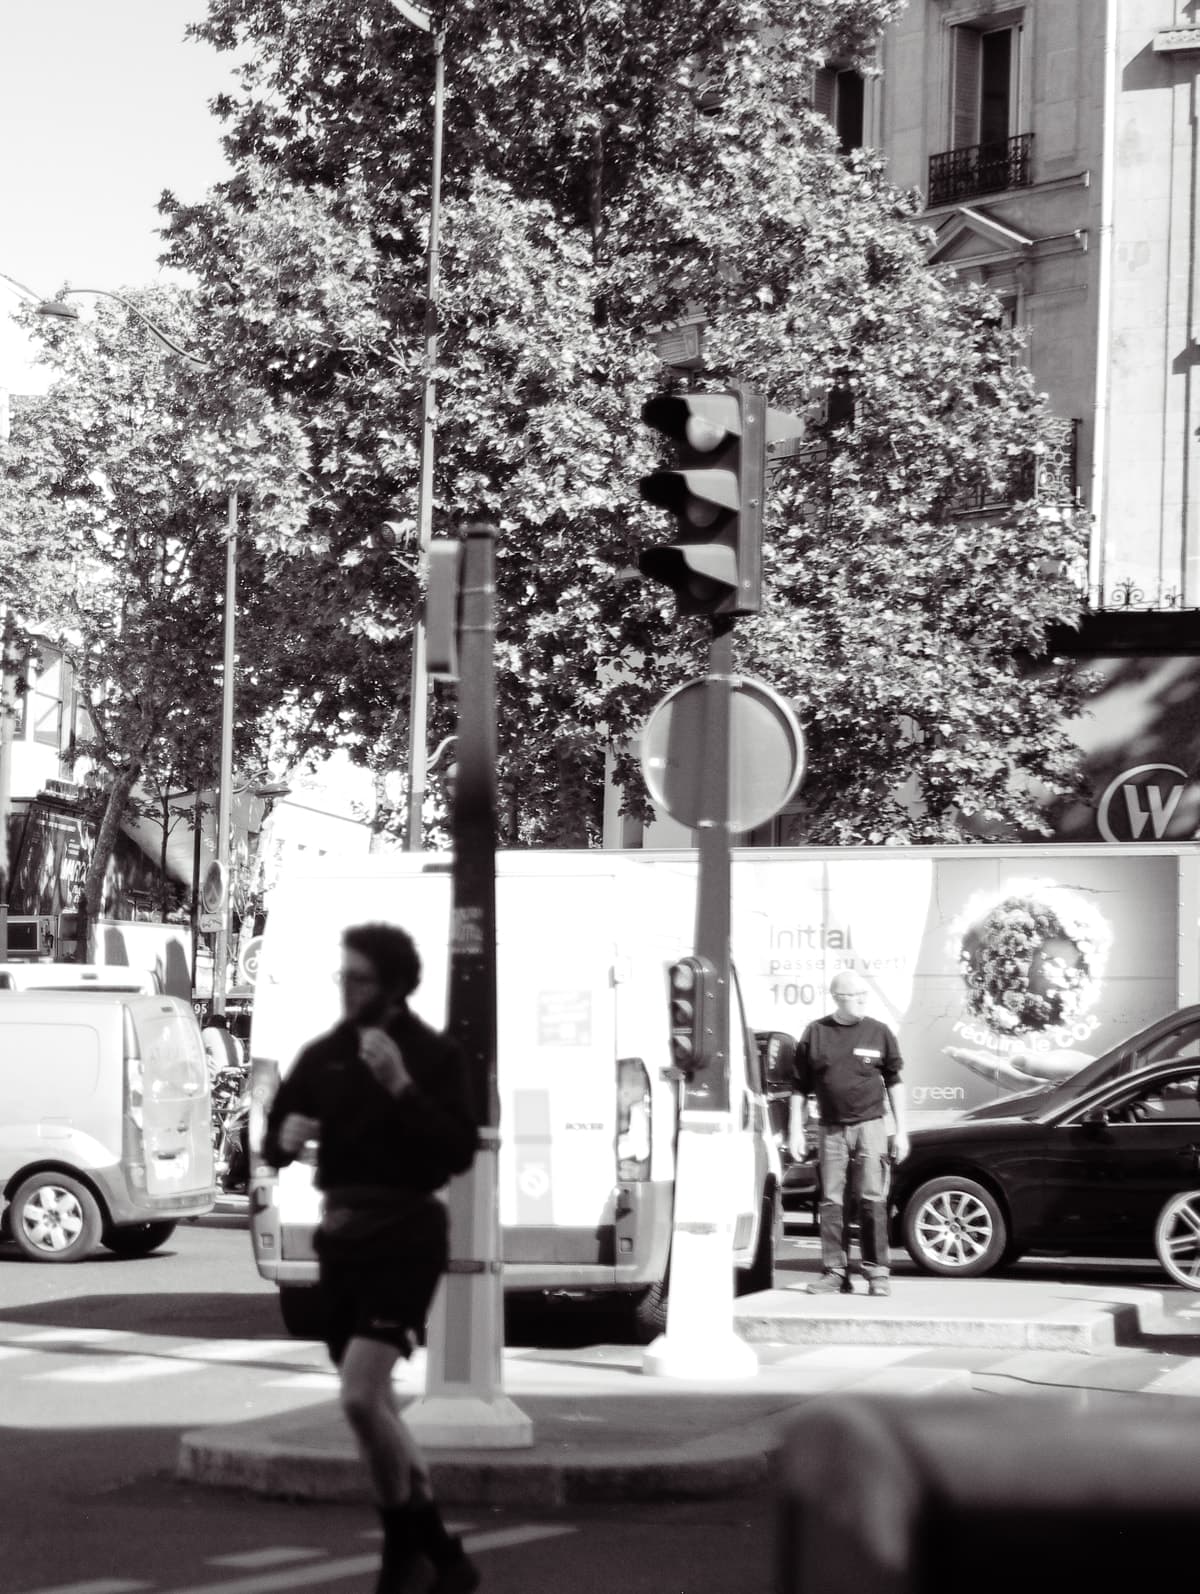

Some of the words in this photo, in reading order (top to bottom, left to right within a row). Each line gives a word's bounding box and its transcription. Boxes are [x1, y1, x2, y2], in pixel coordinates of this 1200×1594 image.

[769, 923, 852, 950] Initial
[769, 959, 825, 975] passe
[834, 959, 855, 970] au
[1031, 1034, 1050, 1050] le
[911, 1085, 965, 1104] green
